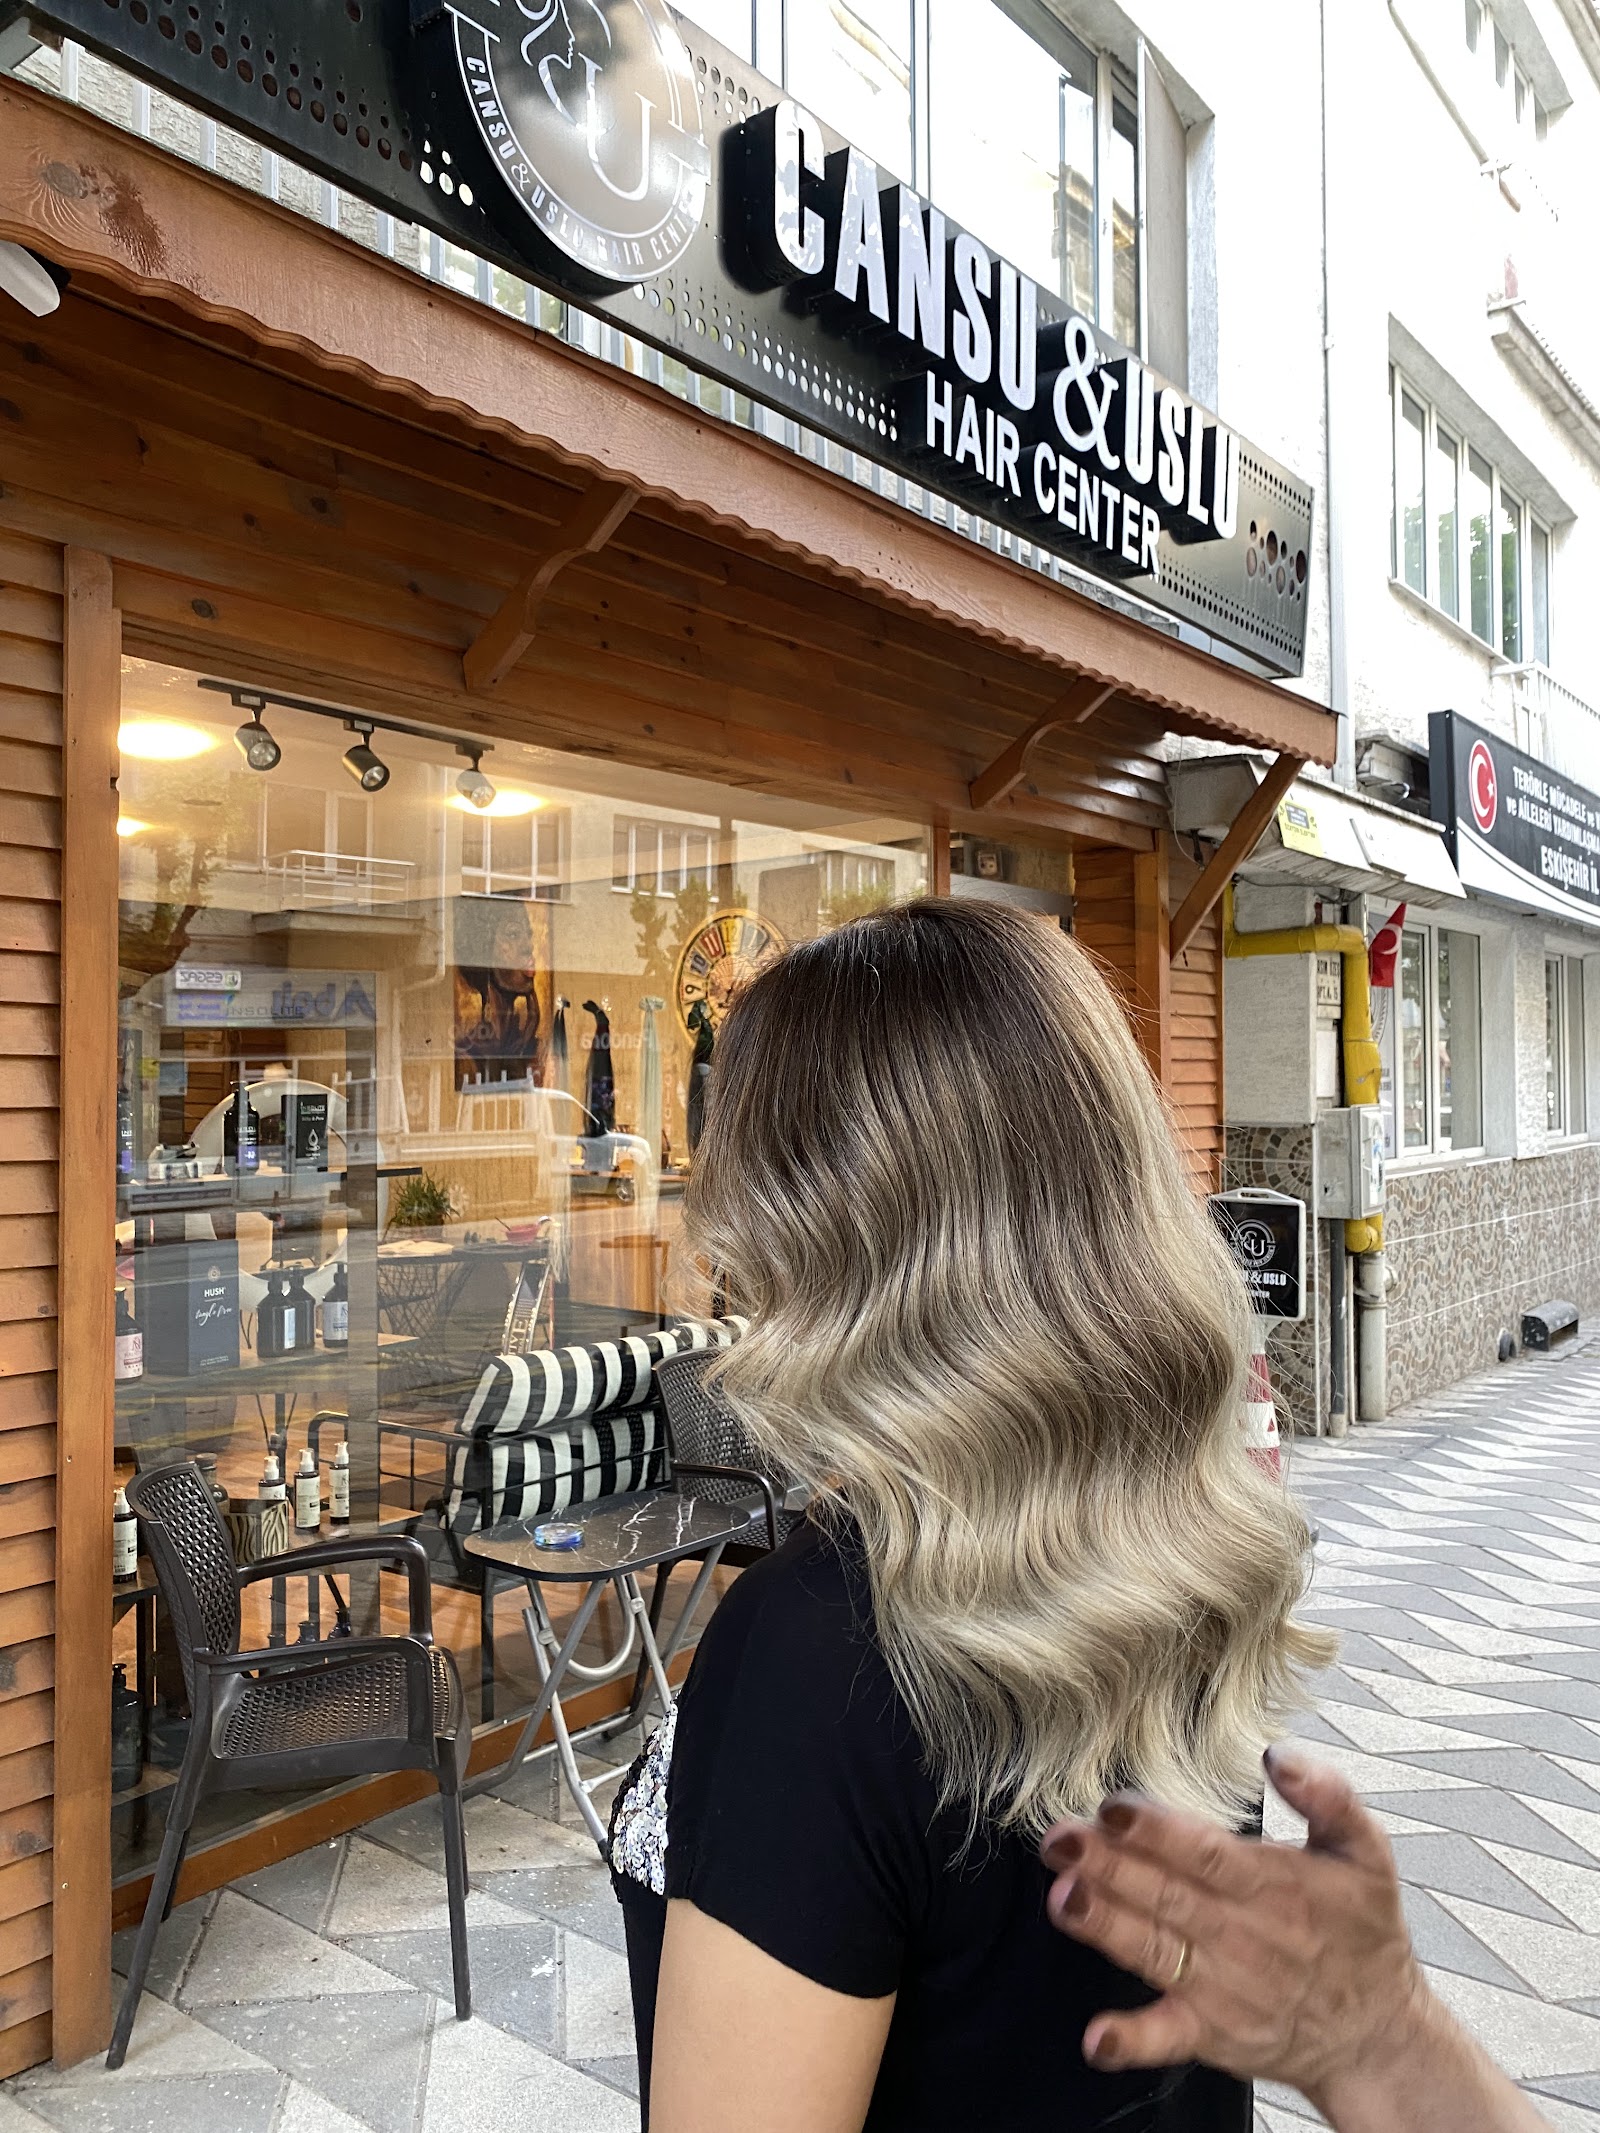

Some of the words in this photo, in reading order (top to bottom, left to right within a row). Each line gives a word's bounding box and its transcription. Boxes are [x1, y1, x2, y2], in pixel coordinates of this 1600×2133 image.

[466, 56, 516, 160] CANSU
[511, 162, 530, 192] &
[775, 99, 1037, 412] CANSU
[1124, 356, 1240, 539] USLU
[926, 370, 1022, 498] HAIR
[1034, 442, 1161, 575] CENTER
[1513, 766, 1549, 803] TERÖRLE
[1541, 845, 1590, 891] ESKİŞEHİR
[685, 984, 702, 995] 9
[1263, 1273, 1287, 1286] USLU
